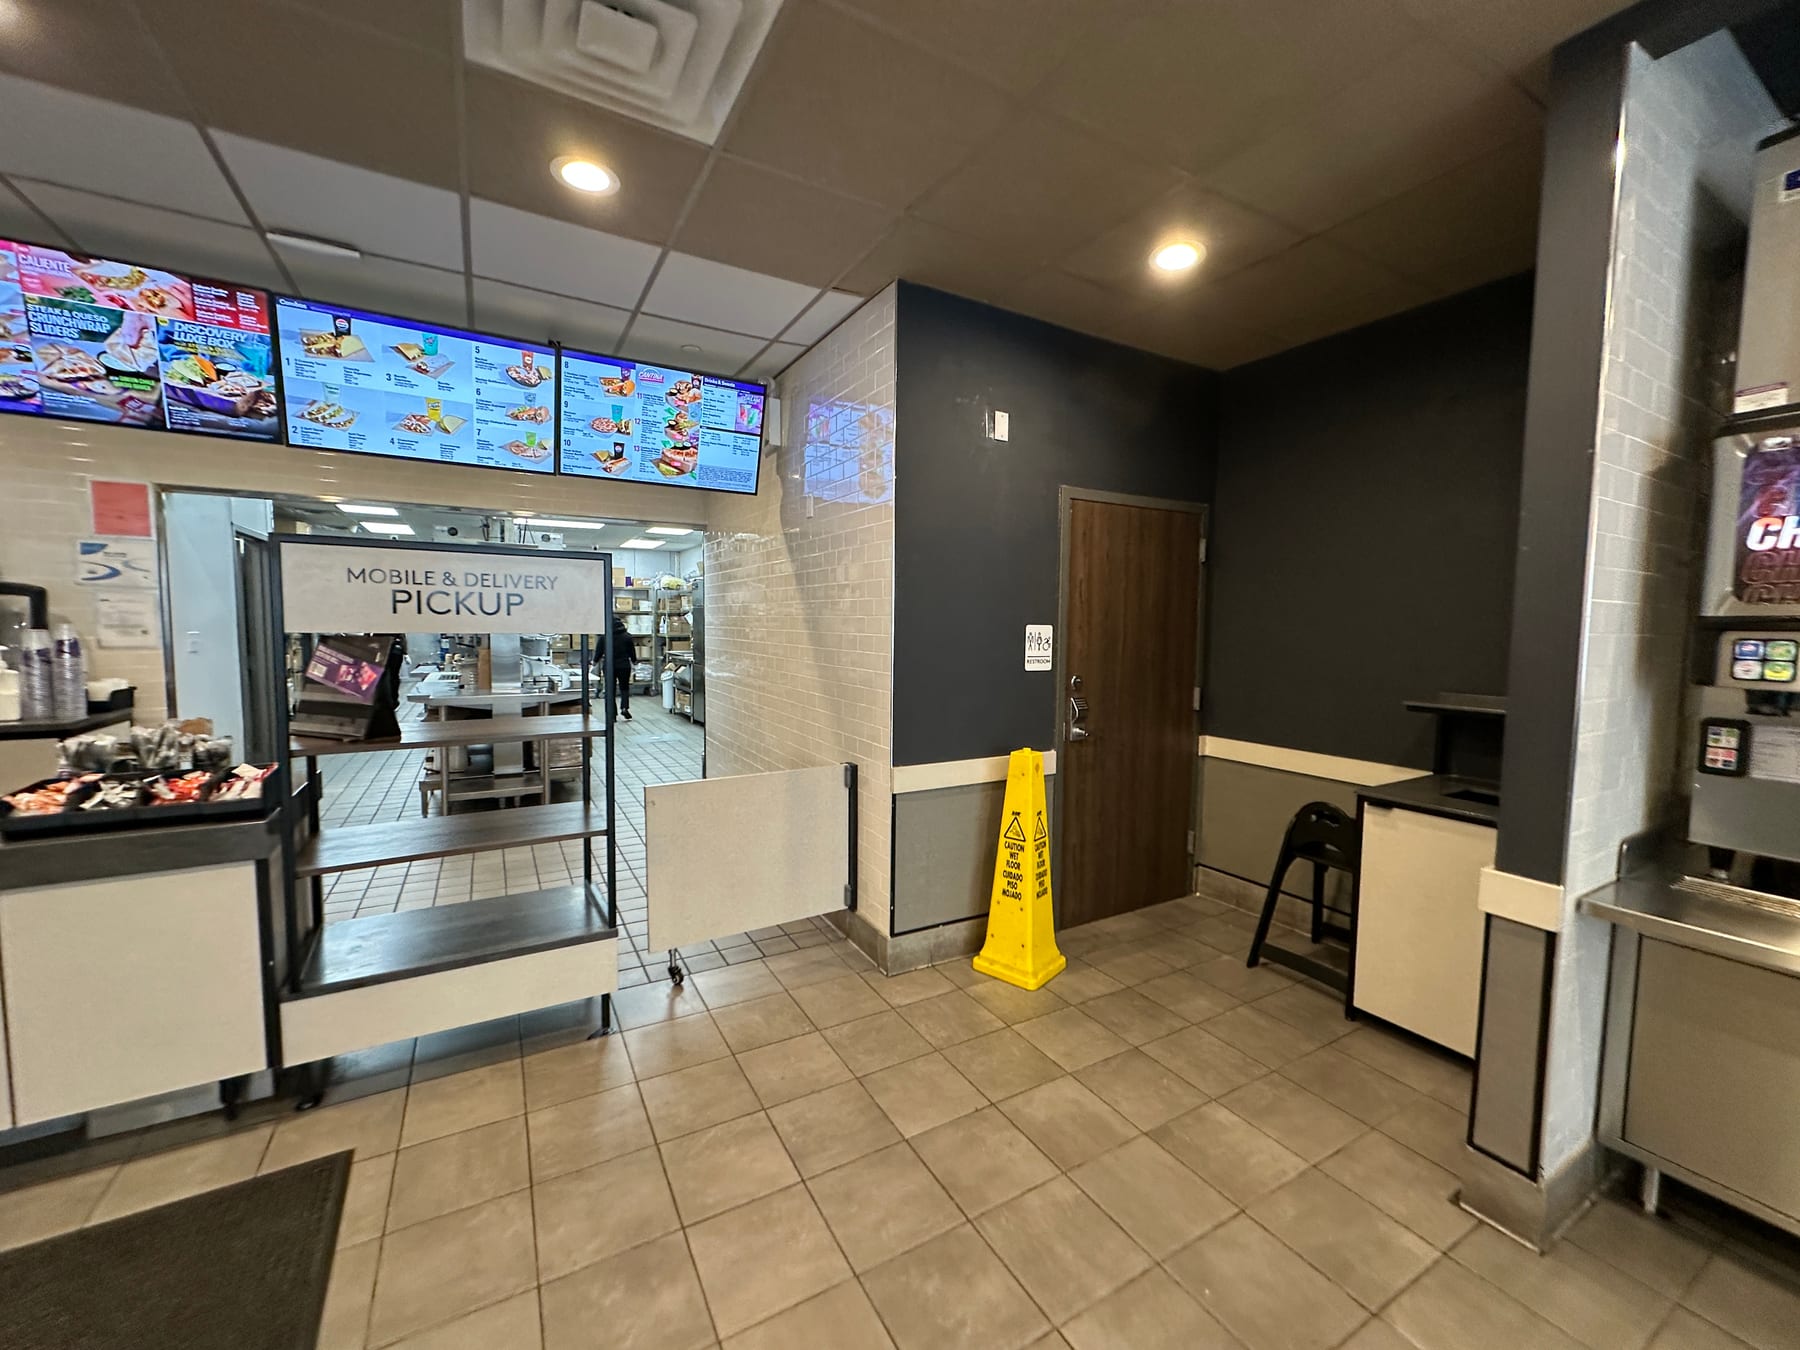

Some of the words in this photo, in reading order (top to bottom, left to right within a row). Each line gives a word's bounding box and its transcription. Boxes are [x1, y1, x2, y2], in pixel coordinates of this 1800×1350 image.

[18, 254, 71, 273] CALIENTE
[26, 303, 62, 315] STEAK
[73, 311, 109, 324] QUESO
[28, 311, 111, 334] CRUNCHWRAP
[174, 321, 247, 342] DISCOVERY
[173, 331, 207, 345] LUXE
[207, 337, 235, 349] BOX
[475, 345, 480, 354] 5
[564, 361, 569, 369] 8
[385, 373, 392, 381] 3
[476, 388, 481, 396] 6
[563, 400, 569, 408] 9
[292, 425, 299, 434] 2
[476, 428, 481, 436] 7
[563, 439, 571, 447] 10
[347, 567, 435, 587] MOBILE
[442, 571, 457, 587] &
[464, 572, 559, 590] DELIVERY
[391, 589, 525, 617] PICKUP
[1004, 841, 1025, 853] CAUTION
[1009, 852, 1019, 861] WET
[1006, 859, 1021, 871] FLOOR
[1002, 870, 1024, 882] CUIDADO
[1007, 880, 1018, 890] PISO
[1001, 889, 1022, 901] MOJADO
